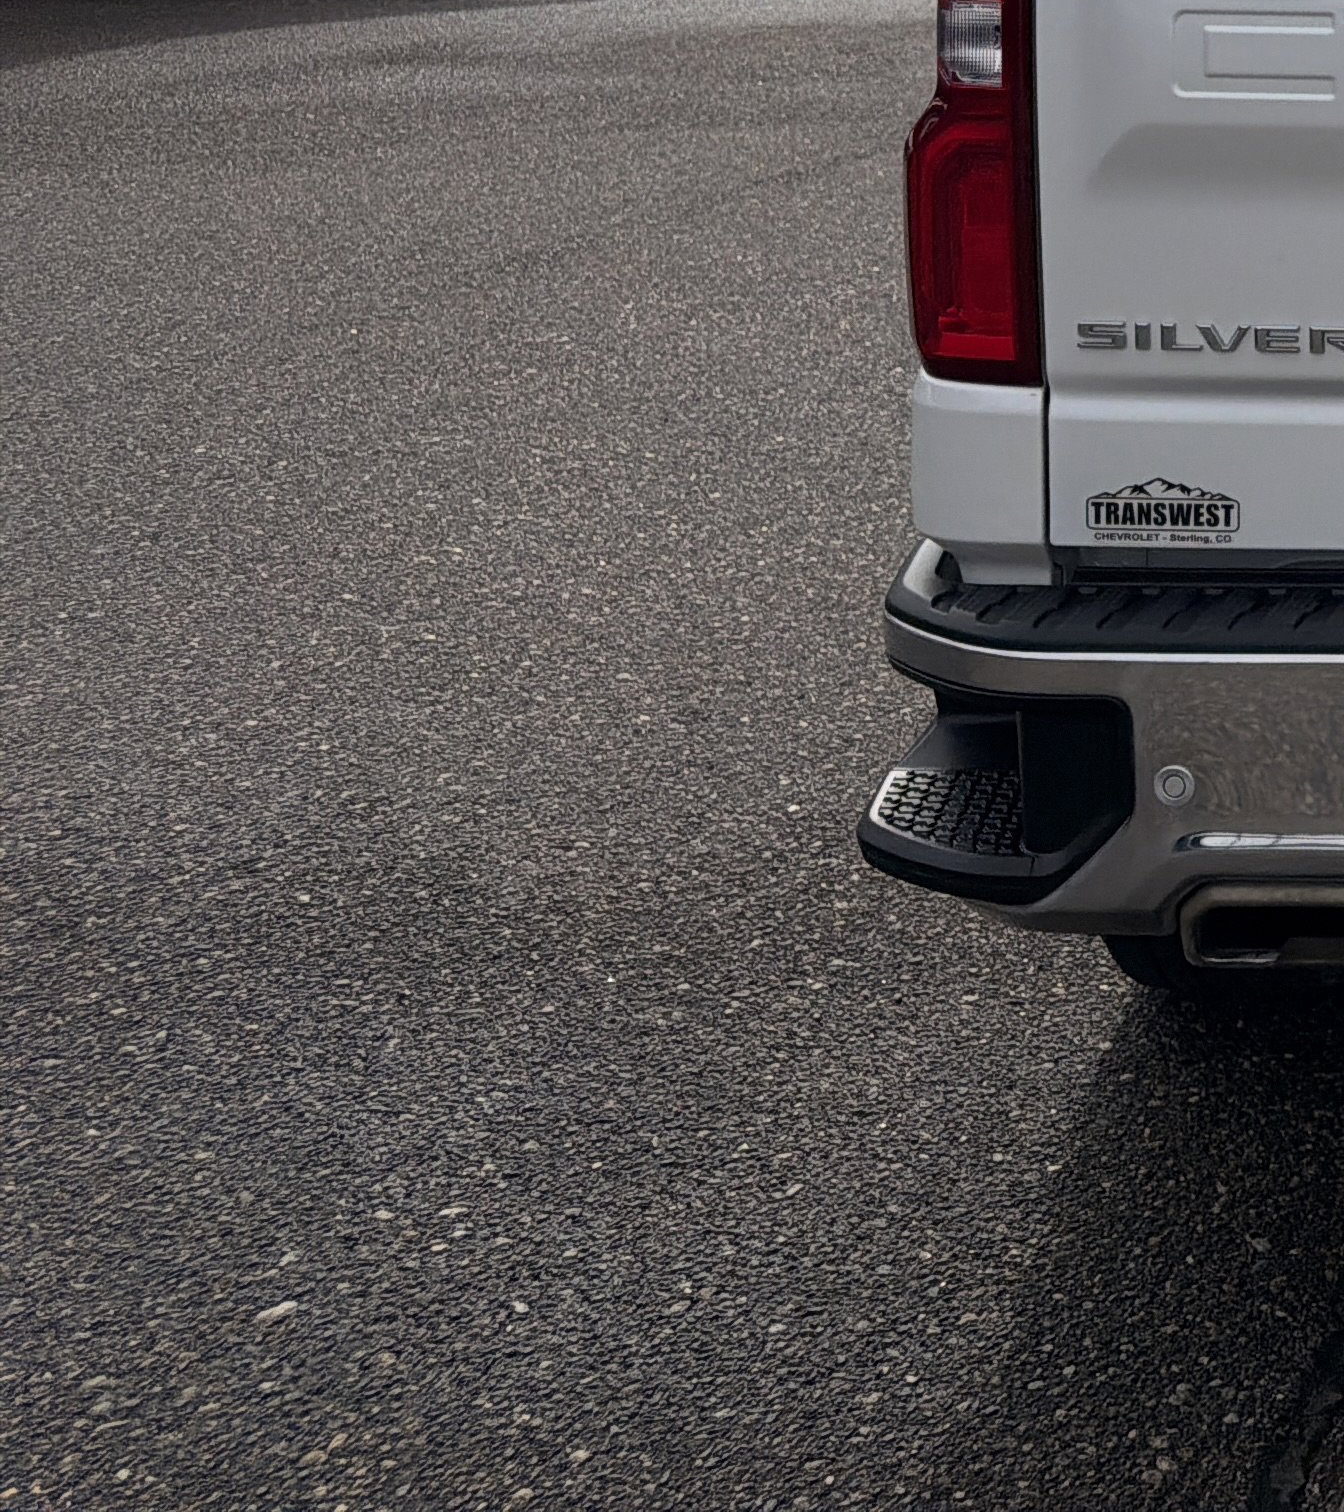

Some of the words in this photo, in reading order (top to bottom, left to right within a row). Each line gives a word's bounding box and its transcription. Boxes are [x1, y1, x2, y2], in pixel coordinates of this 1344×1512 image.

[1090, 500, 1235, 528] TRANSWEST
[1094, 531, 1161, 542] CHEVROLET
[1169, 532, 1213, 544] Sterling,
[1215, 535, 1233, 544] CO
